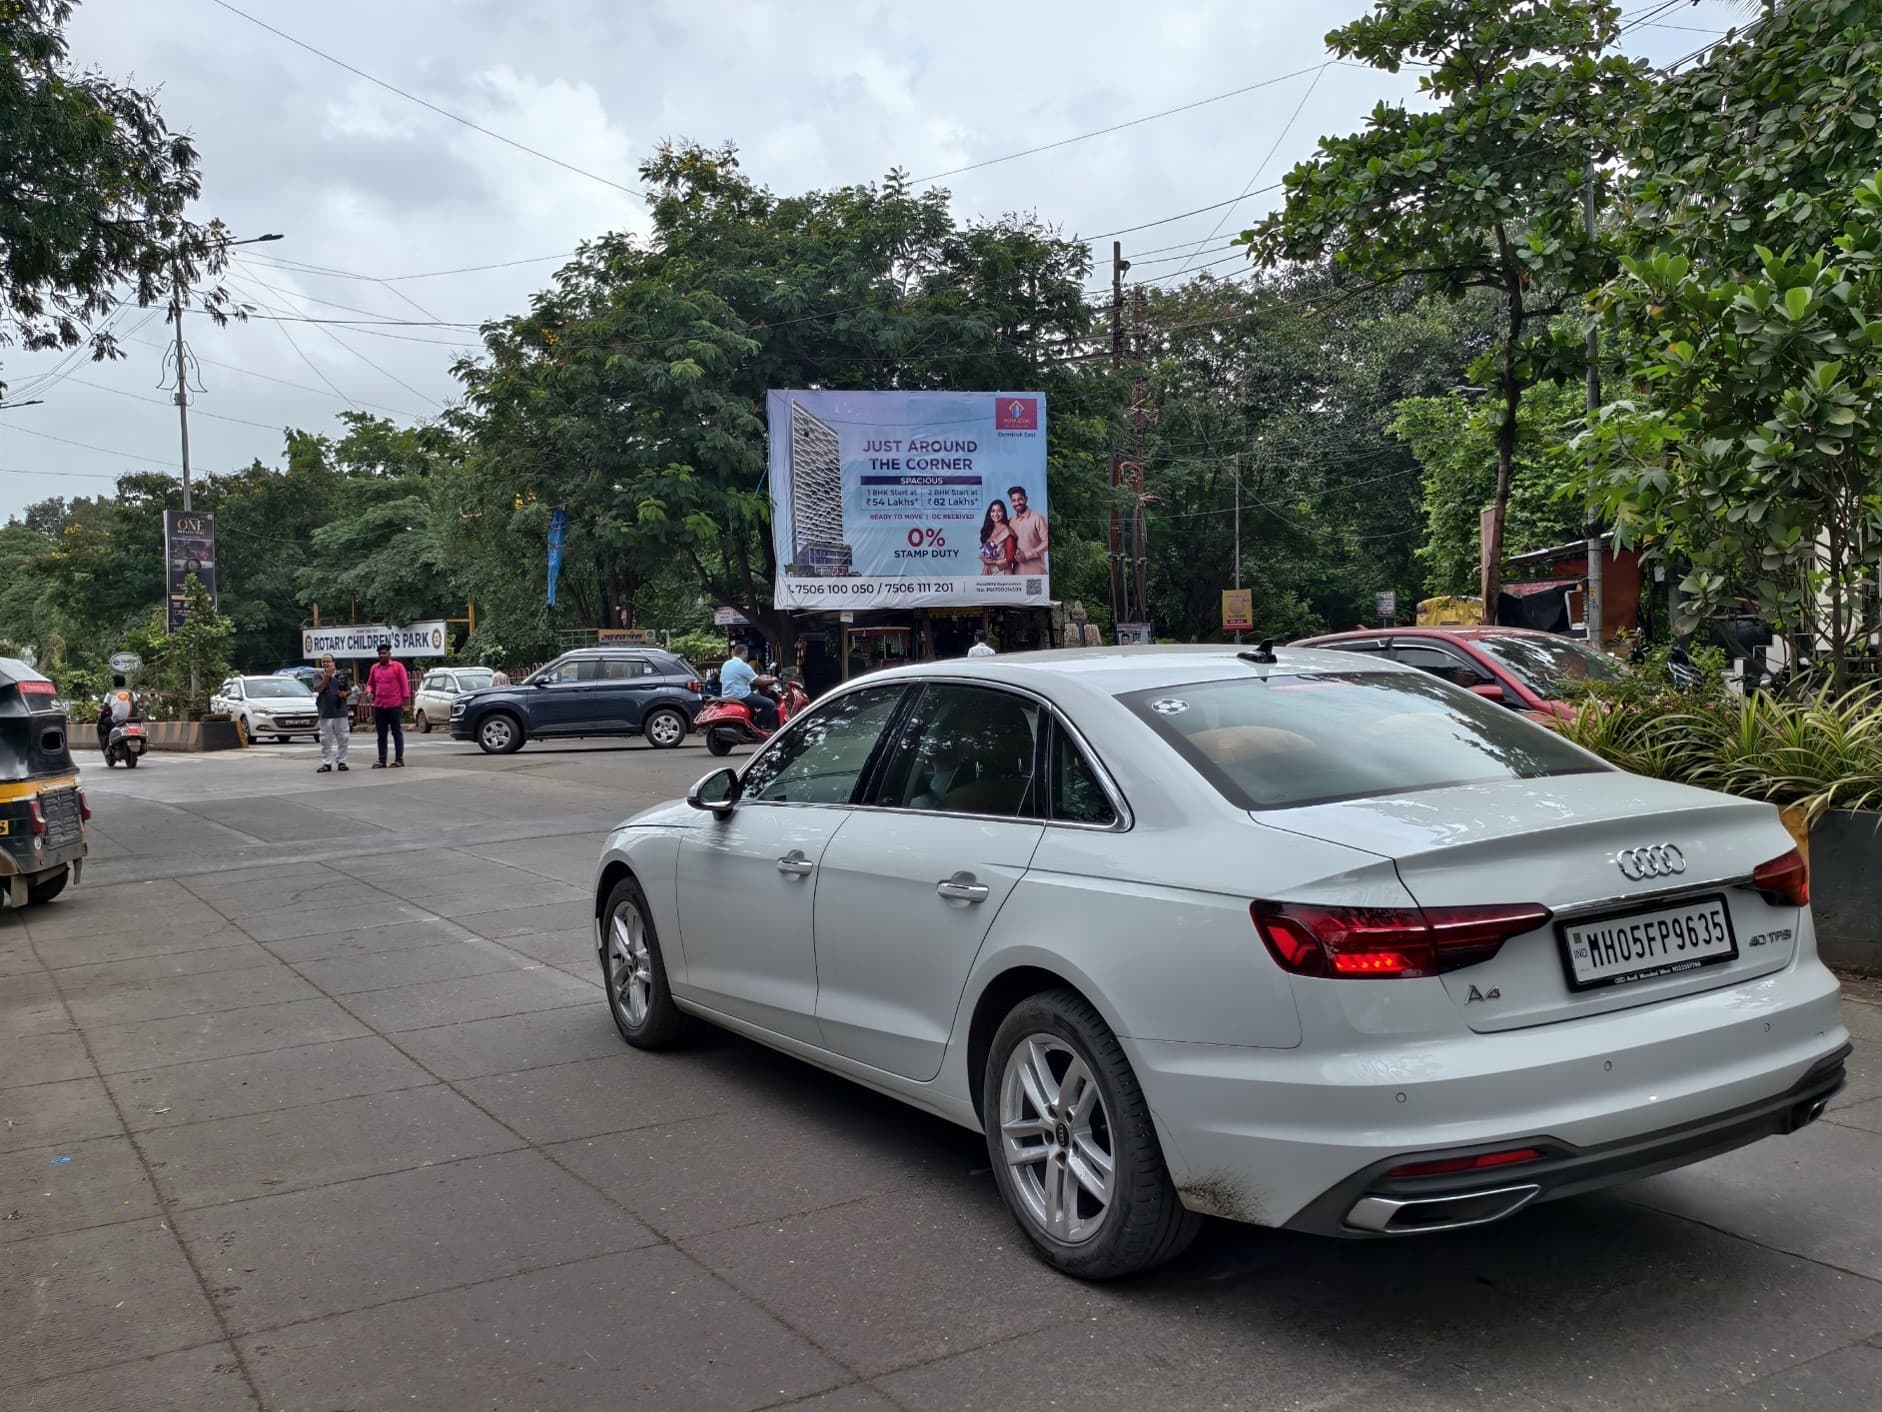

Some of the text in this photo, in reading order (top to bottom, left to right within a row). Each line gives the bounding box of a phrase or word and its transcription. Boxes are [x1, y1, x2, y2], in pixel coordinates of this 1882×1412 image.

[863, 440, 977, 453] JUST AROUND
[869, 458, 973, 470] THE CORNER
[900, 477, 943, 485] SPACIOUS
[177, 519, 205, 531] ONE
[907, 528, 946, 547] 0%
[894, 549, 960, 558] STAMP DUTY
[795, 582, 953, 595] 7506 100 050 / 7506 111 201
[314, 631, 430, 651] ROTARY CHILDREN'S PARK
[1586, 910, 1725, 968] MH05FP9635
[1749, 934, 1766, 948] 40
[1574, 947, 1588, 959] IND
[1464, 984, 1502, 1004] A4
